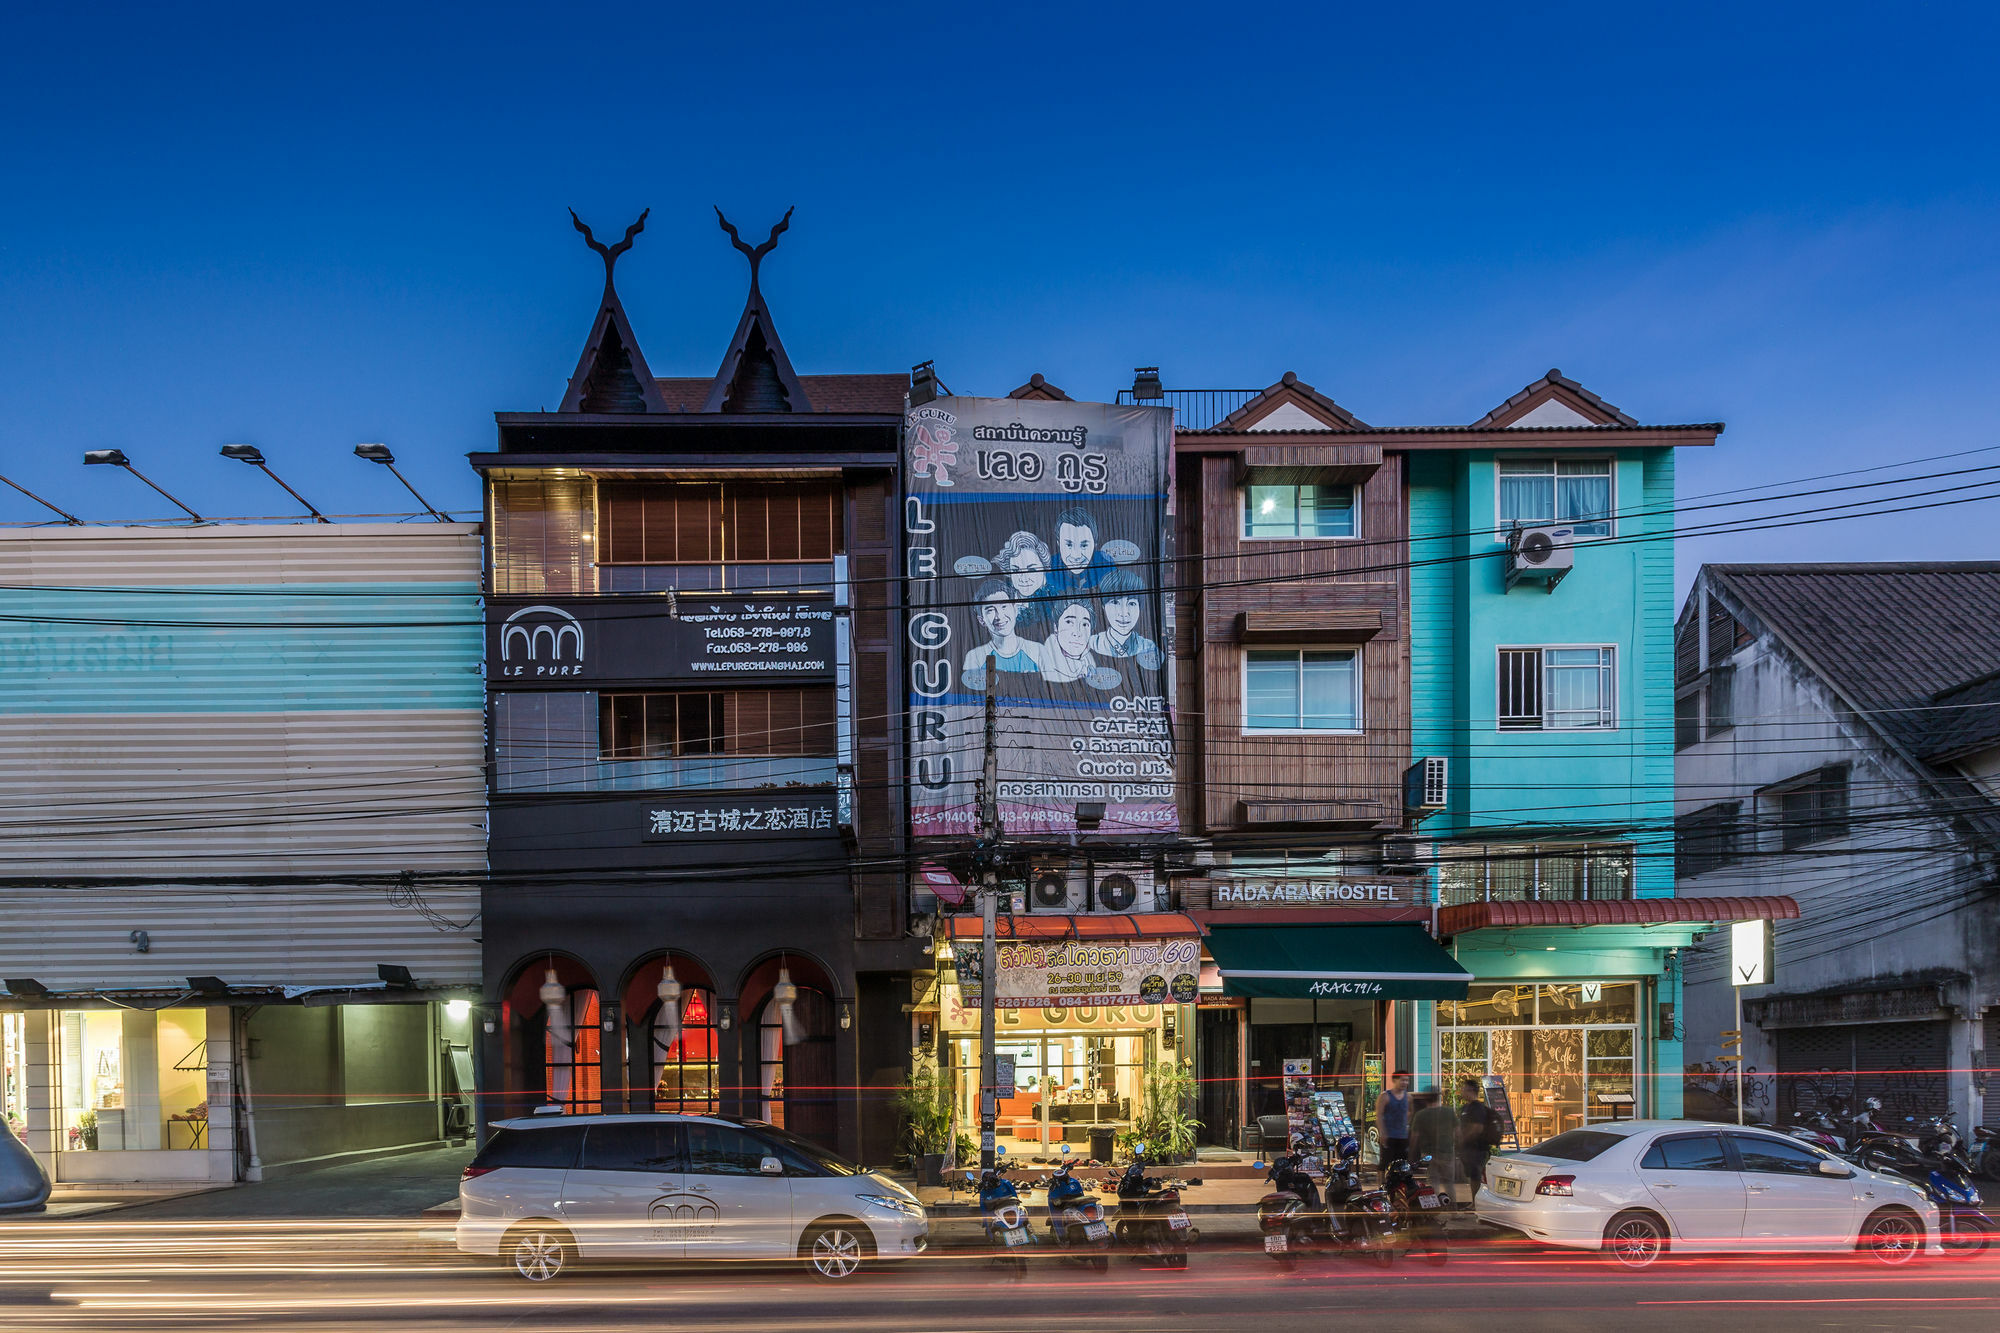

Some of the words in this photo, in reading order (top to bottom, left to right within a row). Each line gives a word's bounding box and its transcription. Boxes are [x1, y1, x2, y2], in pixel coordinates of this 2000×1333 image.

[919, 408, 956, 425] GURU
[974, 423, 1084, 447] สถาบันความรู้
[976, 450, 1043, 481] เลอ
[1056, 452, 1108, 494] กูรู
[503, 665, 524, 677] LE
[536, 664, 583, 677] PURE
[690, 661, 825, 672] WWW.LEPURECHIANGMAI.COM
[1072, 740, 1085, 755] 9
[1078, 759, 1136, 777] Quota
[649, 806, 833, 834] 清迈古城之恋酒店
[1218, 885, 1270, 902] RADA
[1272, 884, 1325, 901] ARAK
[1326, 884, 1400, 902] HOSTEL
[1047, 973, 1082, 985] 26-30
[1309, 981, 1353, 996] ARAK
[1354, 981, 1382, 995] 79/4
[1059, 995, 1140, 1007] 084-1507475
[1554, 1046, 1579, 1069] Coffee
